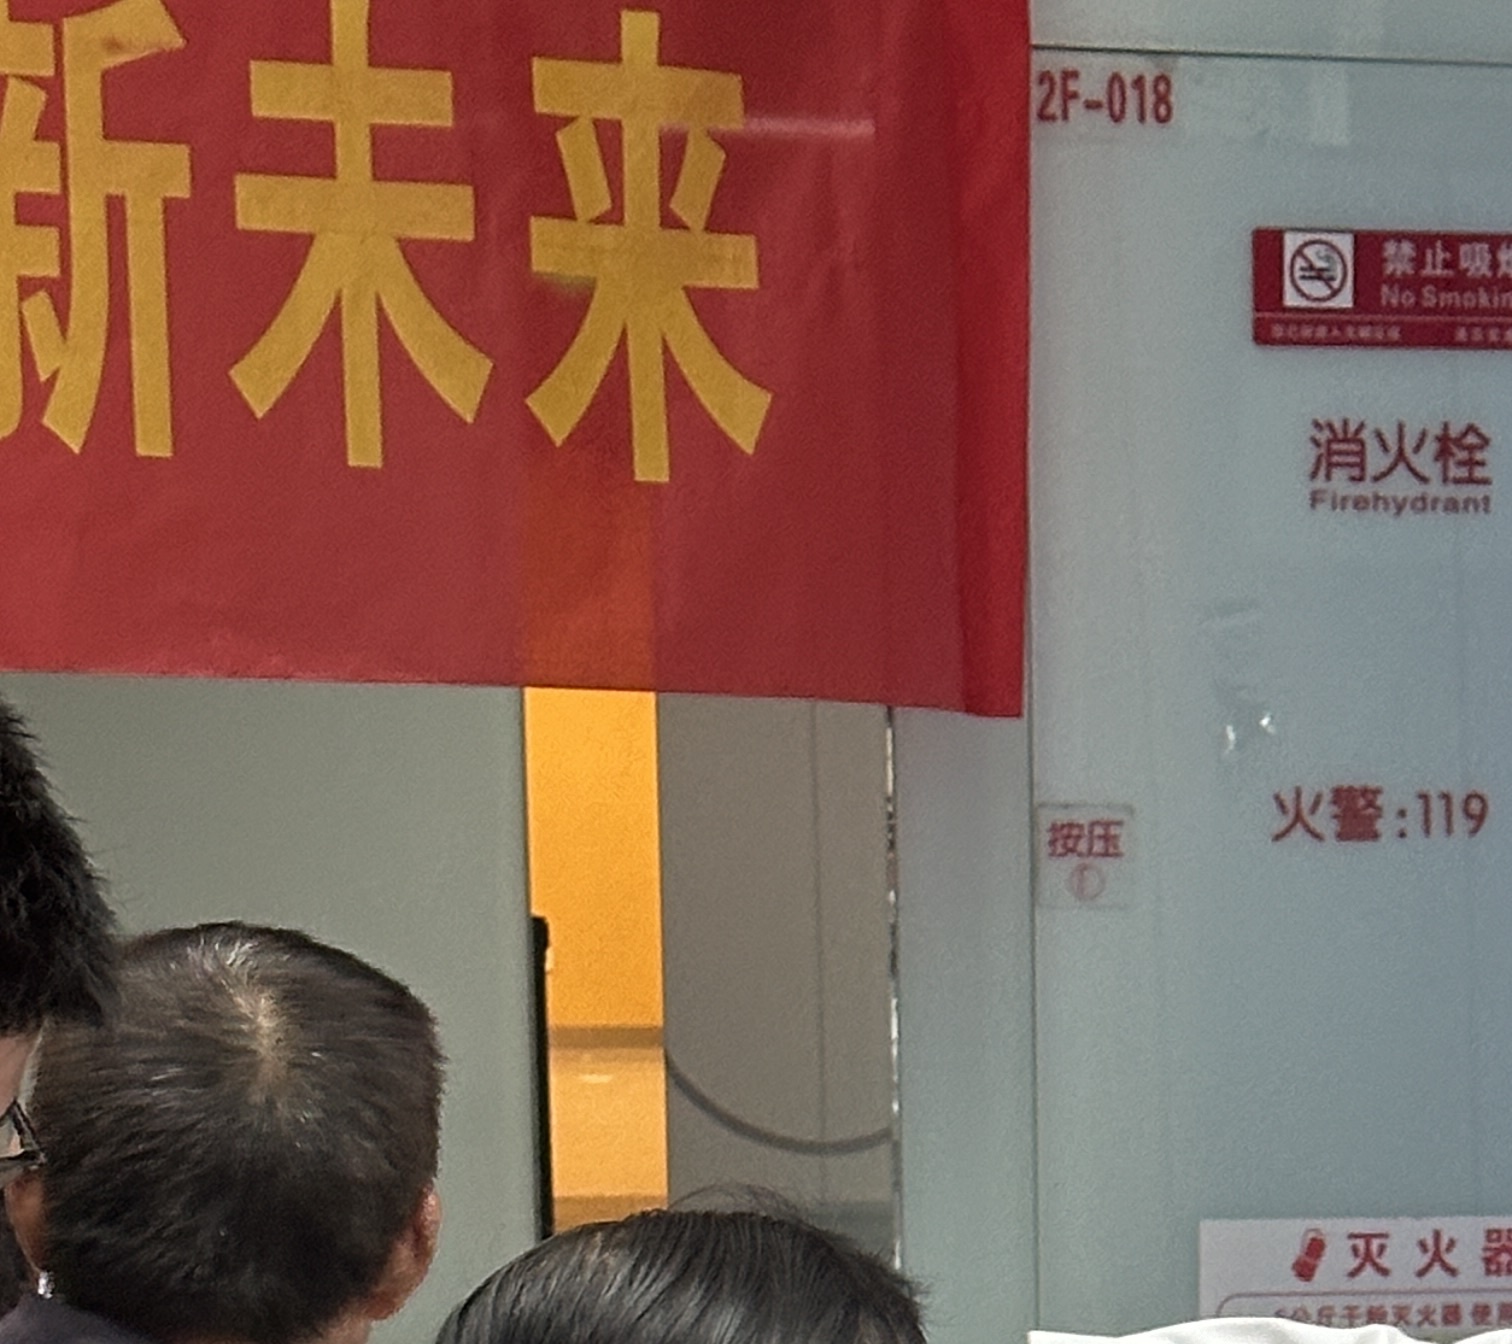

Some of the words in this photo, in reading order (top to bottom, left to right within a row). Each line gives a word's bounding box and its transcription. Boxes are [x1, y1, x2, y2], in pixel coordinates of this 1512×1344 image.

[1036, 69, 1175, 125] 2F-018
[0, 0, 772, 482] 新未来
[1381, 284, 1416, 308] No
[1308, 418, 1493, 487] 消火栓
[1047, 819, 1126, 859] 按压
